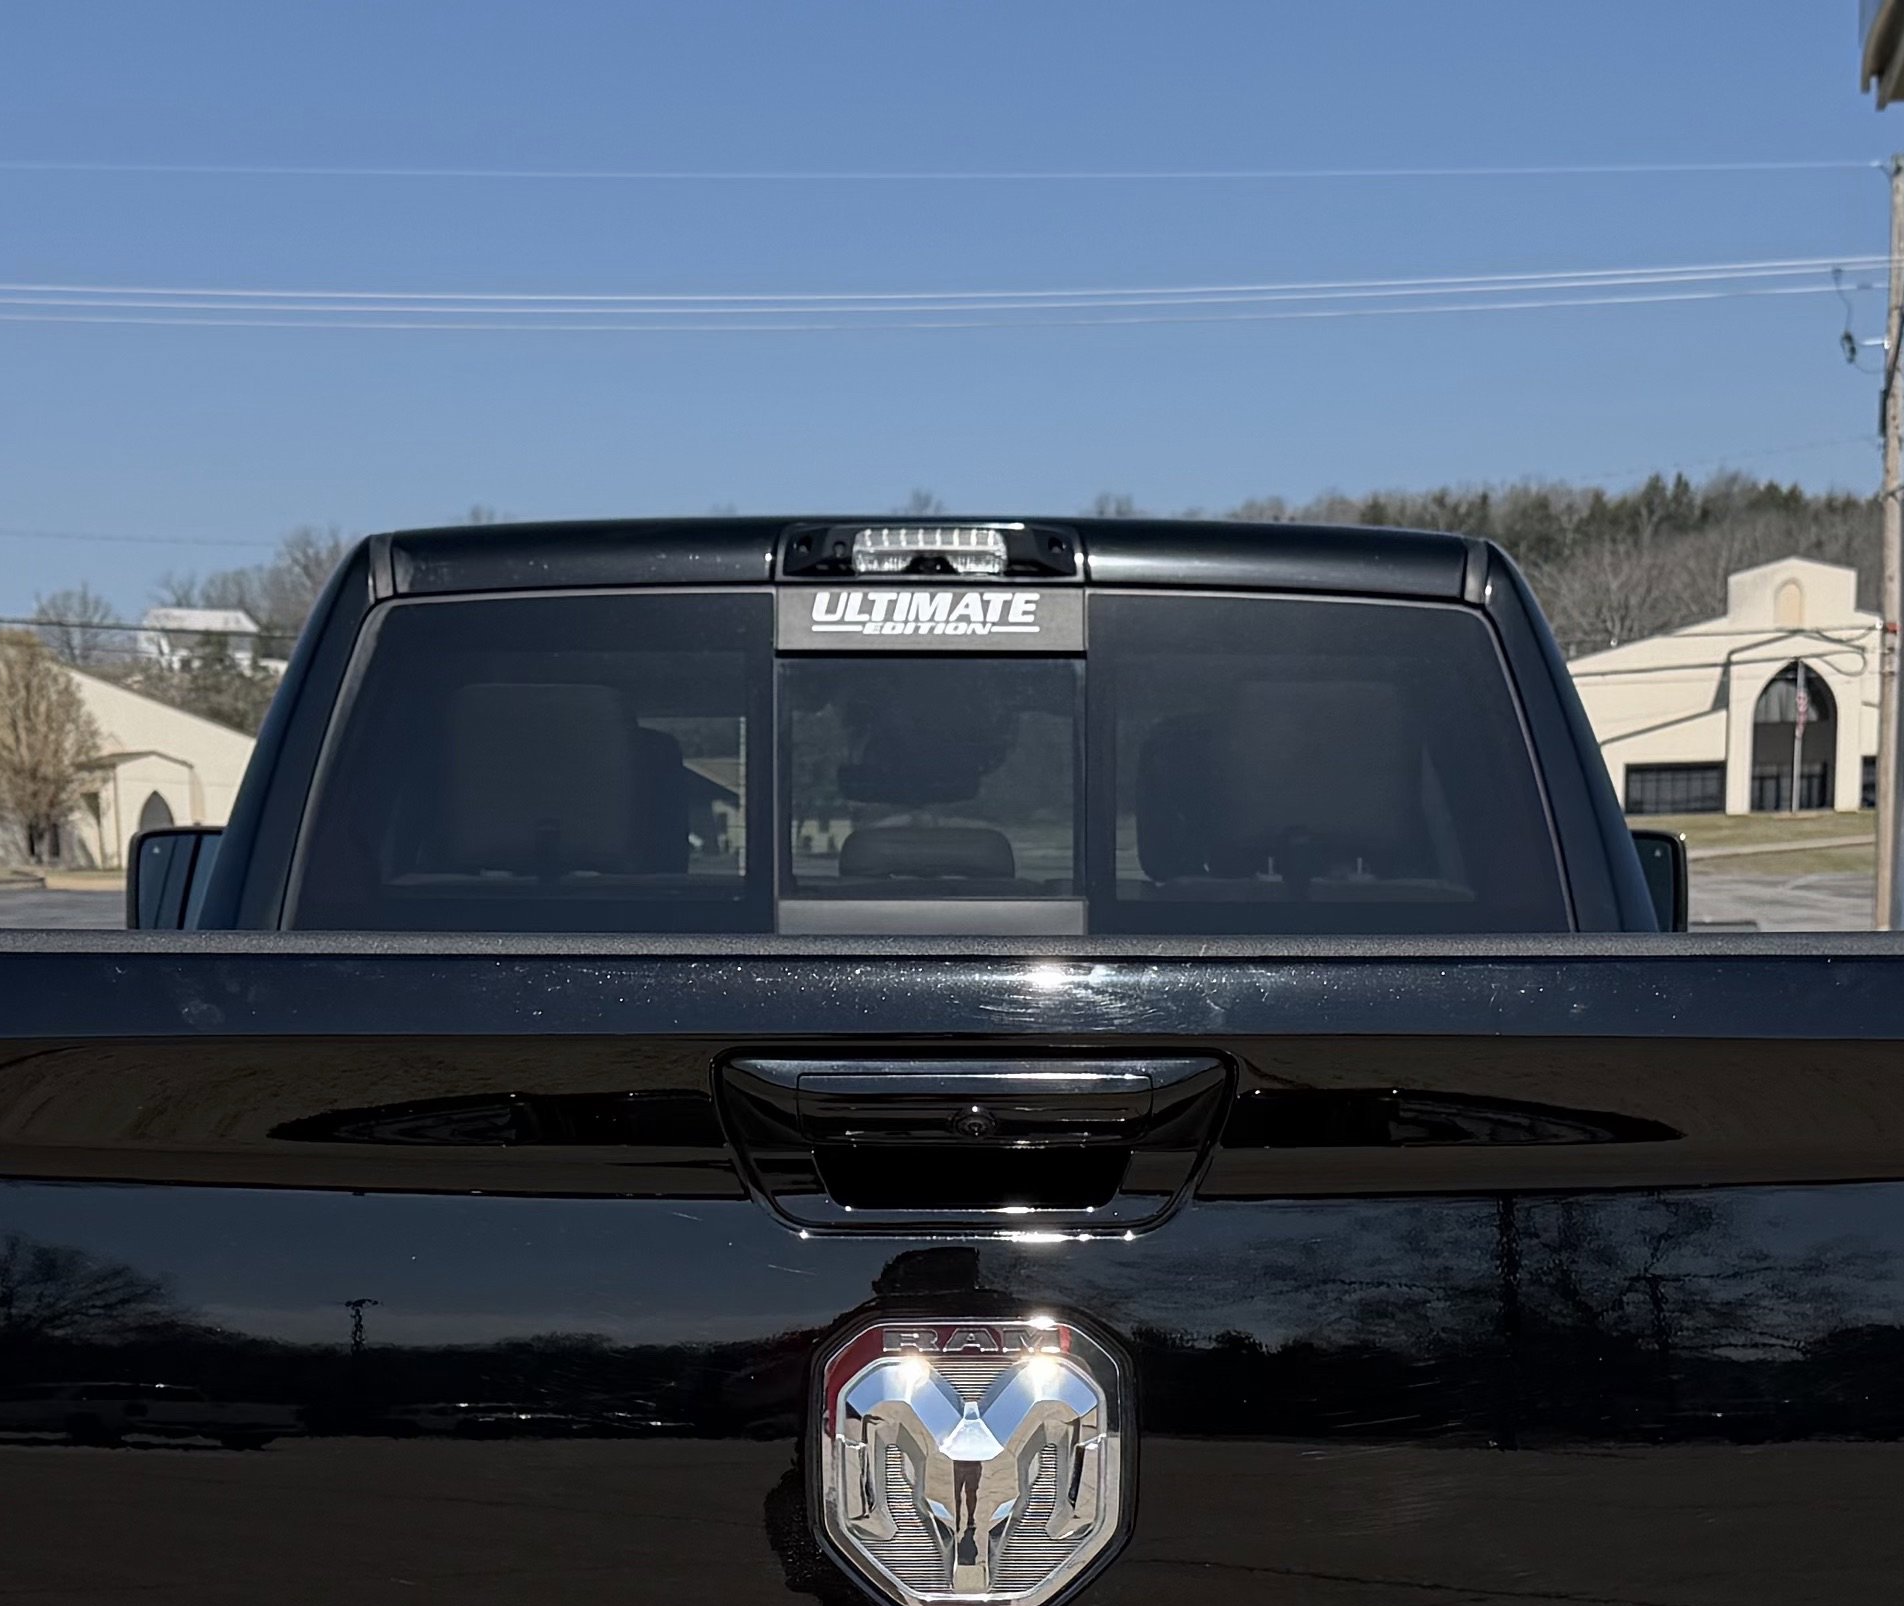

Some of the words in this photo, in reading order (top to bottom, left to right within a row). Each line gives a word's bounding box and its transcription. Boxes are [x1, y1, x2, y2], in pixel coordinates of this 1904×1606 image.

[811, 591, 1040, 622] ULTIMATE
[862, 622, 994, 635] EDITION
[882, 1327, 1061, 1353] RAM
